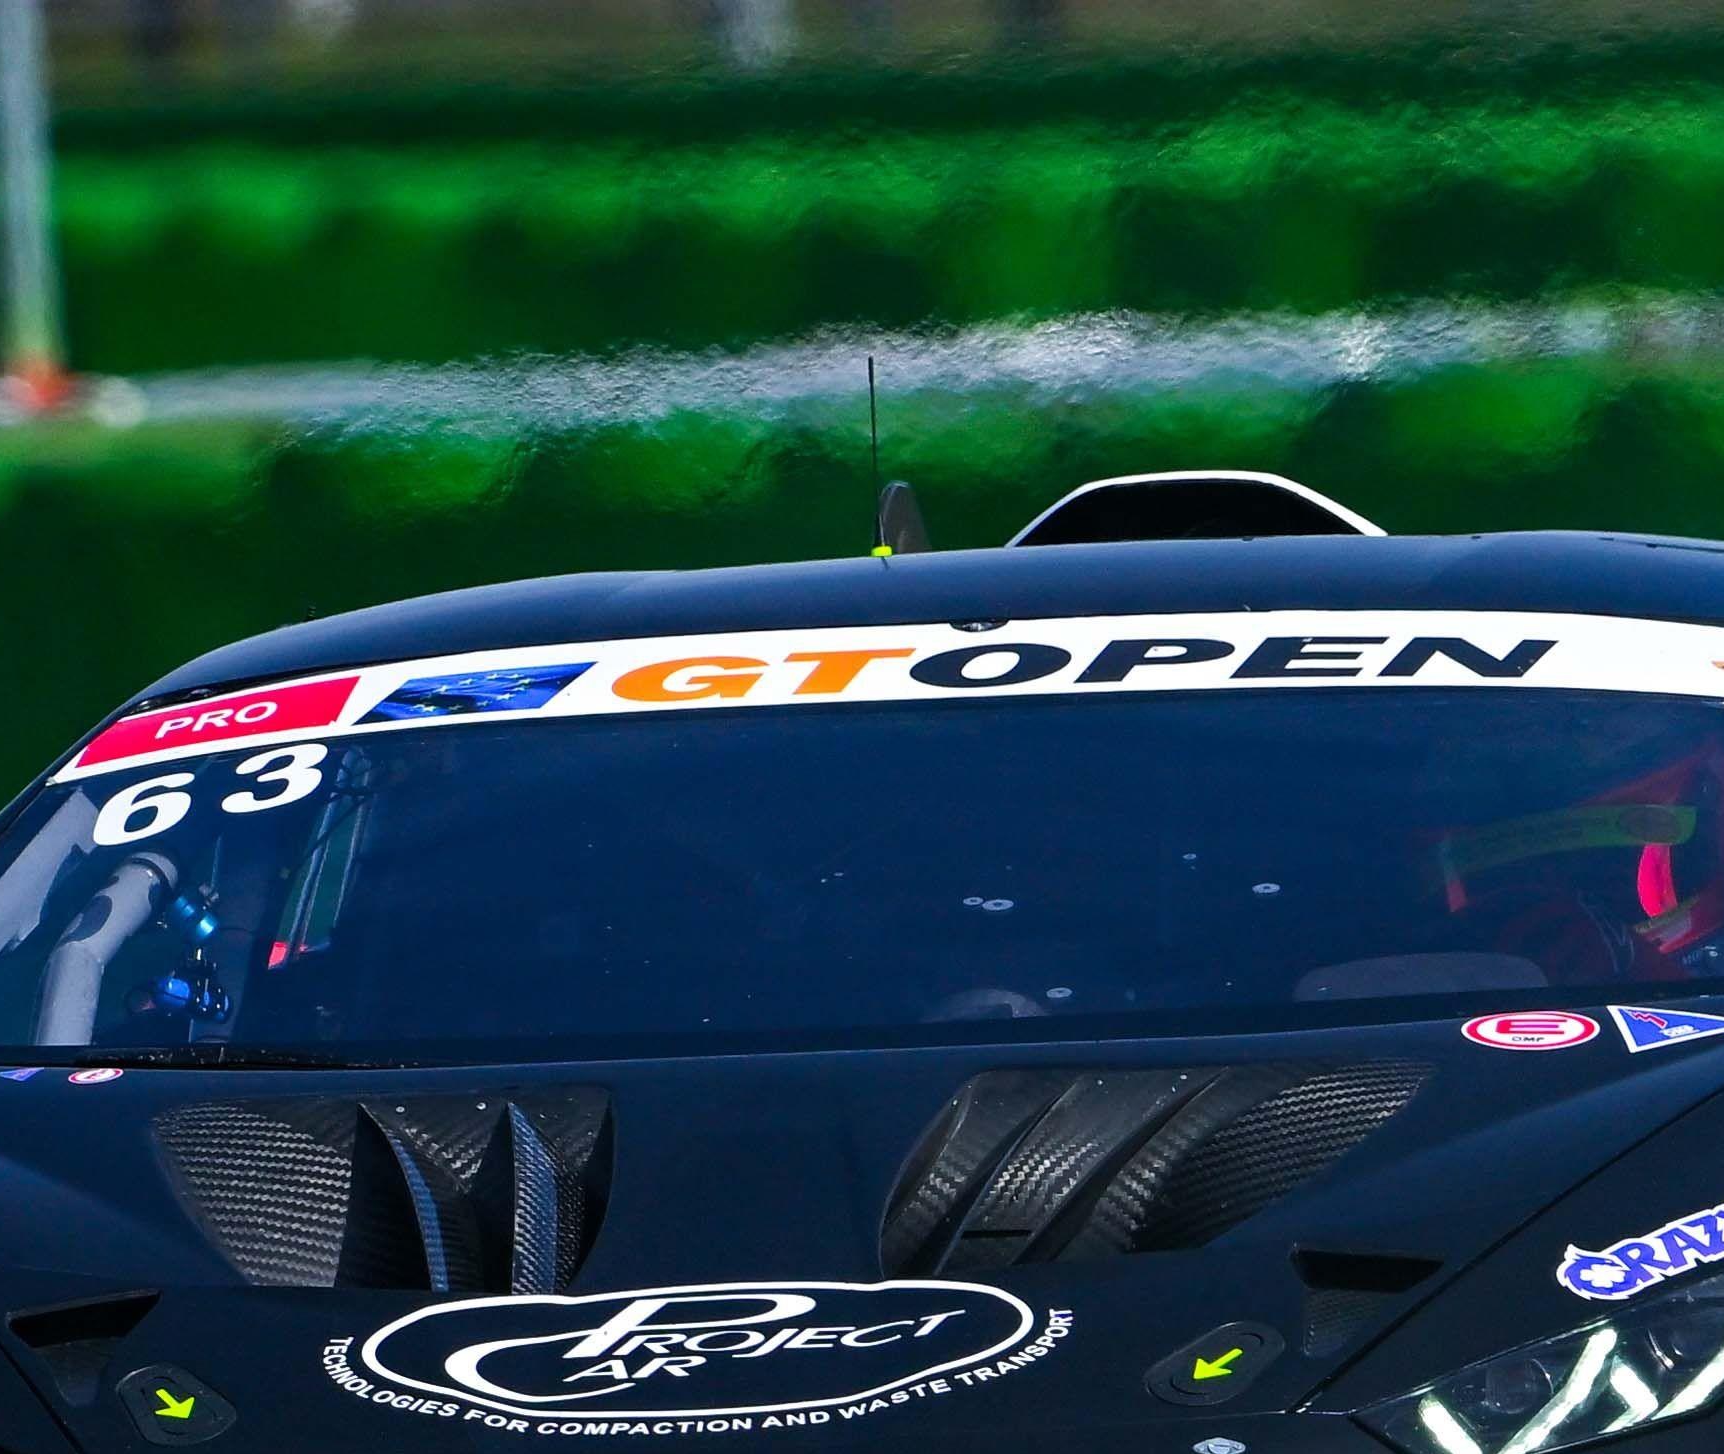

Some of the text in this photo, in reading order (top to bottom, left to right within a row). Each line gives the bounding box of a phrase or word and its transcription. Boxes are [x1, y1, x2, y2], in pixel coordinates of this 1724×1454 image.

[154, 700, 279, 741] PRO
[561, 1293, 966, 1359] PROJECT
[322, 1307, 1075, 1435] TECHNOLOGIES FOR COMPACTION AND WASTE TRANSPORT
